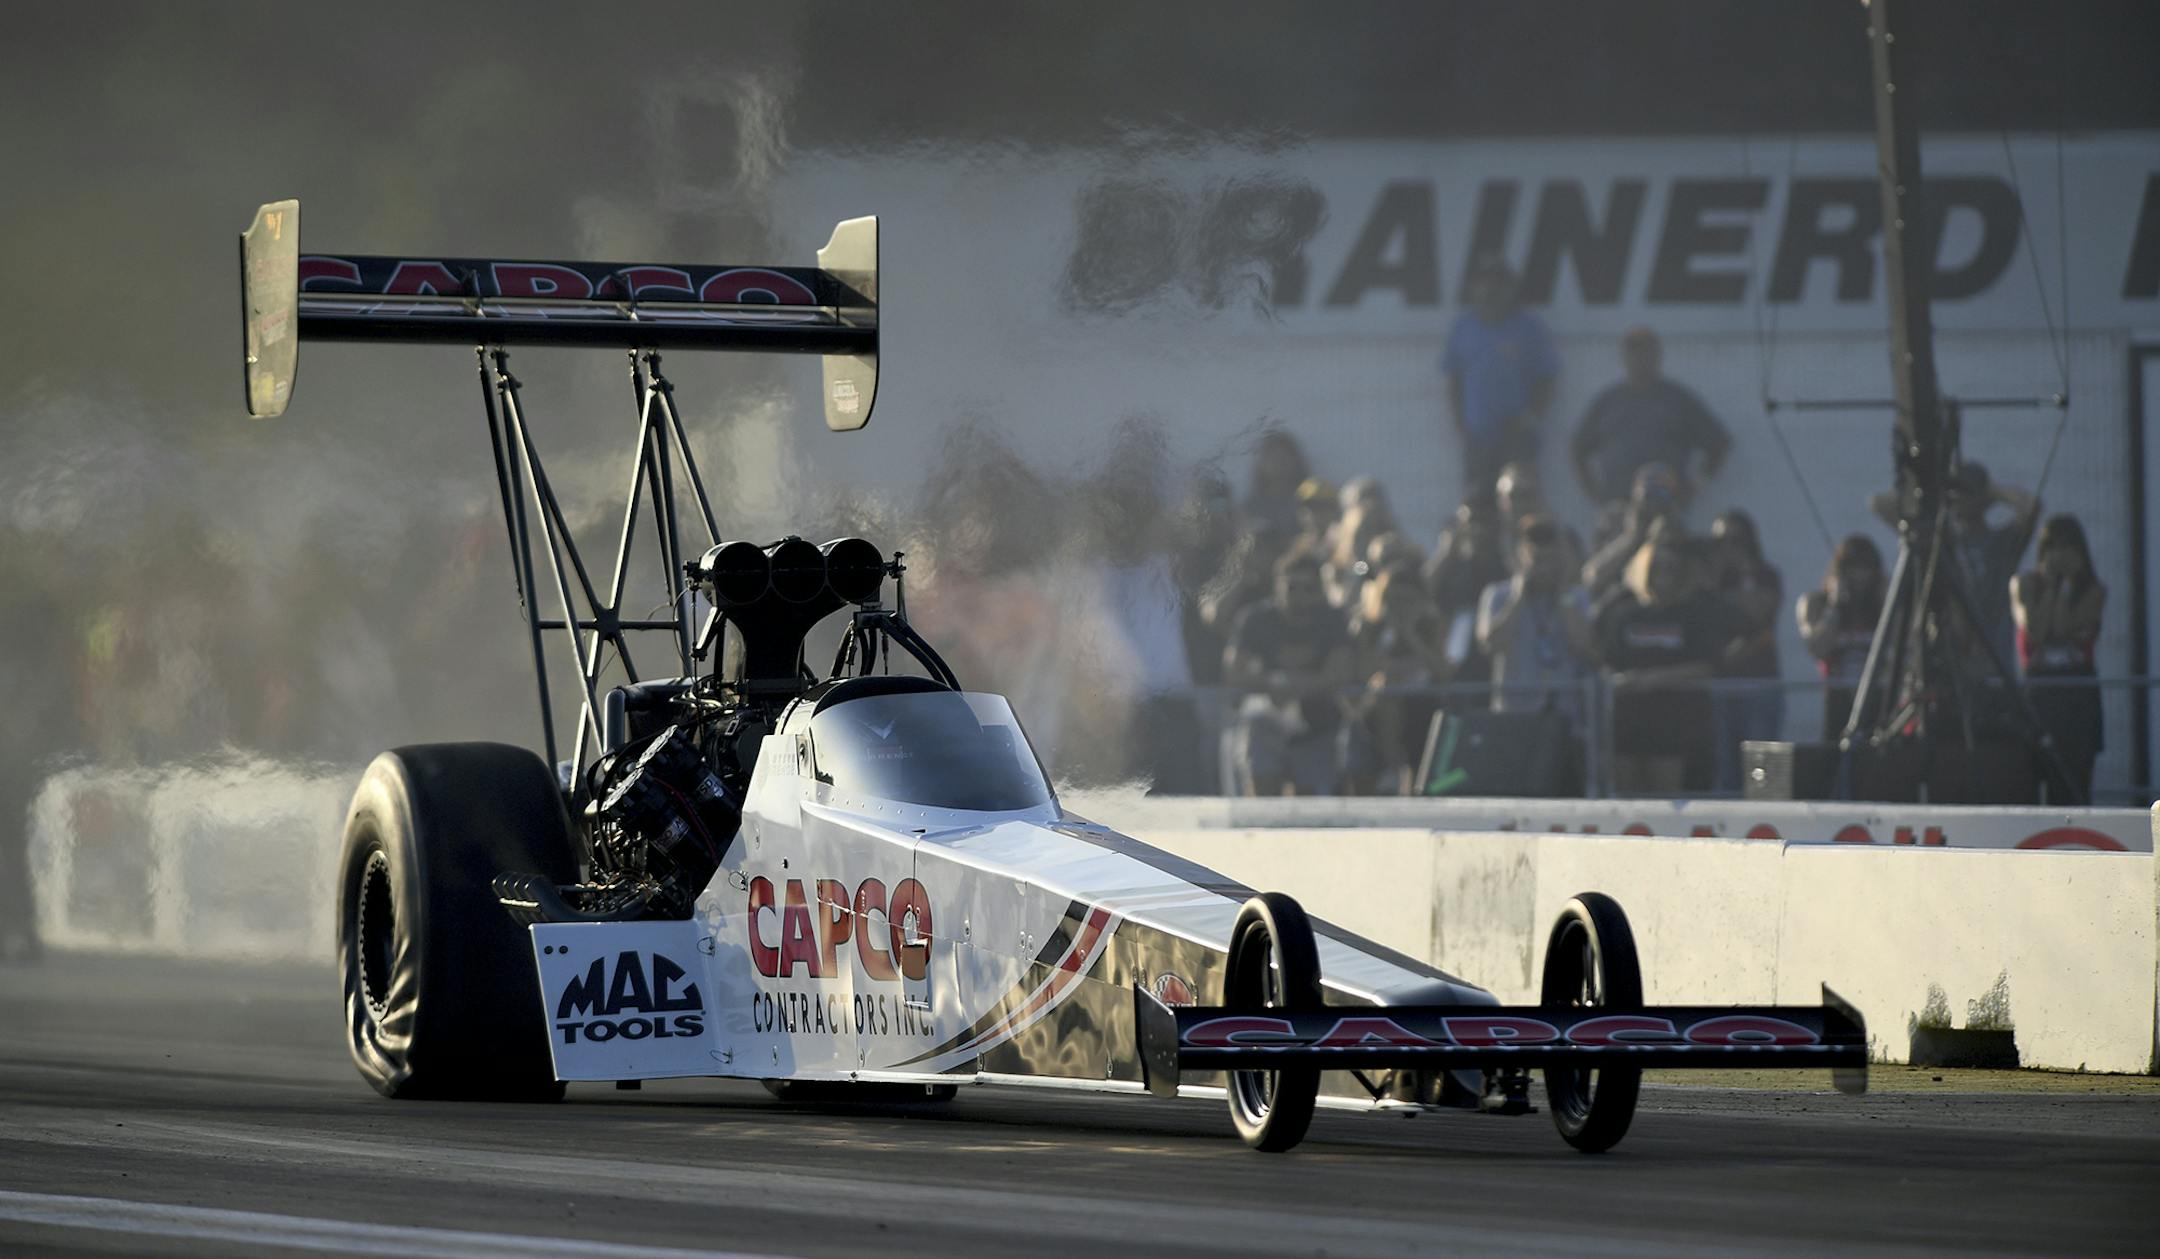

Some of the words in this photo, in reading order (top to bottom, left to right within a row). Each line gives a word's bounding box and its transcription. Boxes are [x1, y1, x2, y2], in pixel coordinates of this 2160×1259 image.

[748, 877, 933, 981] CAPCO
[557, 951, 704, 1018] MAC
[557, 1014, 704, 1044] TOOLS
[753, 993, 888, 1034] CONTRACTORS
[1182, 1016, 1820, 1052] CAPCO
